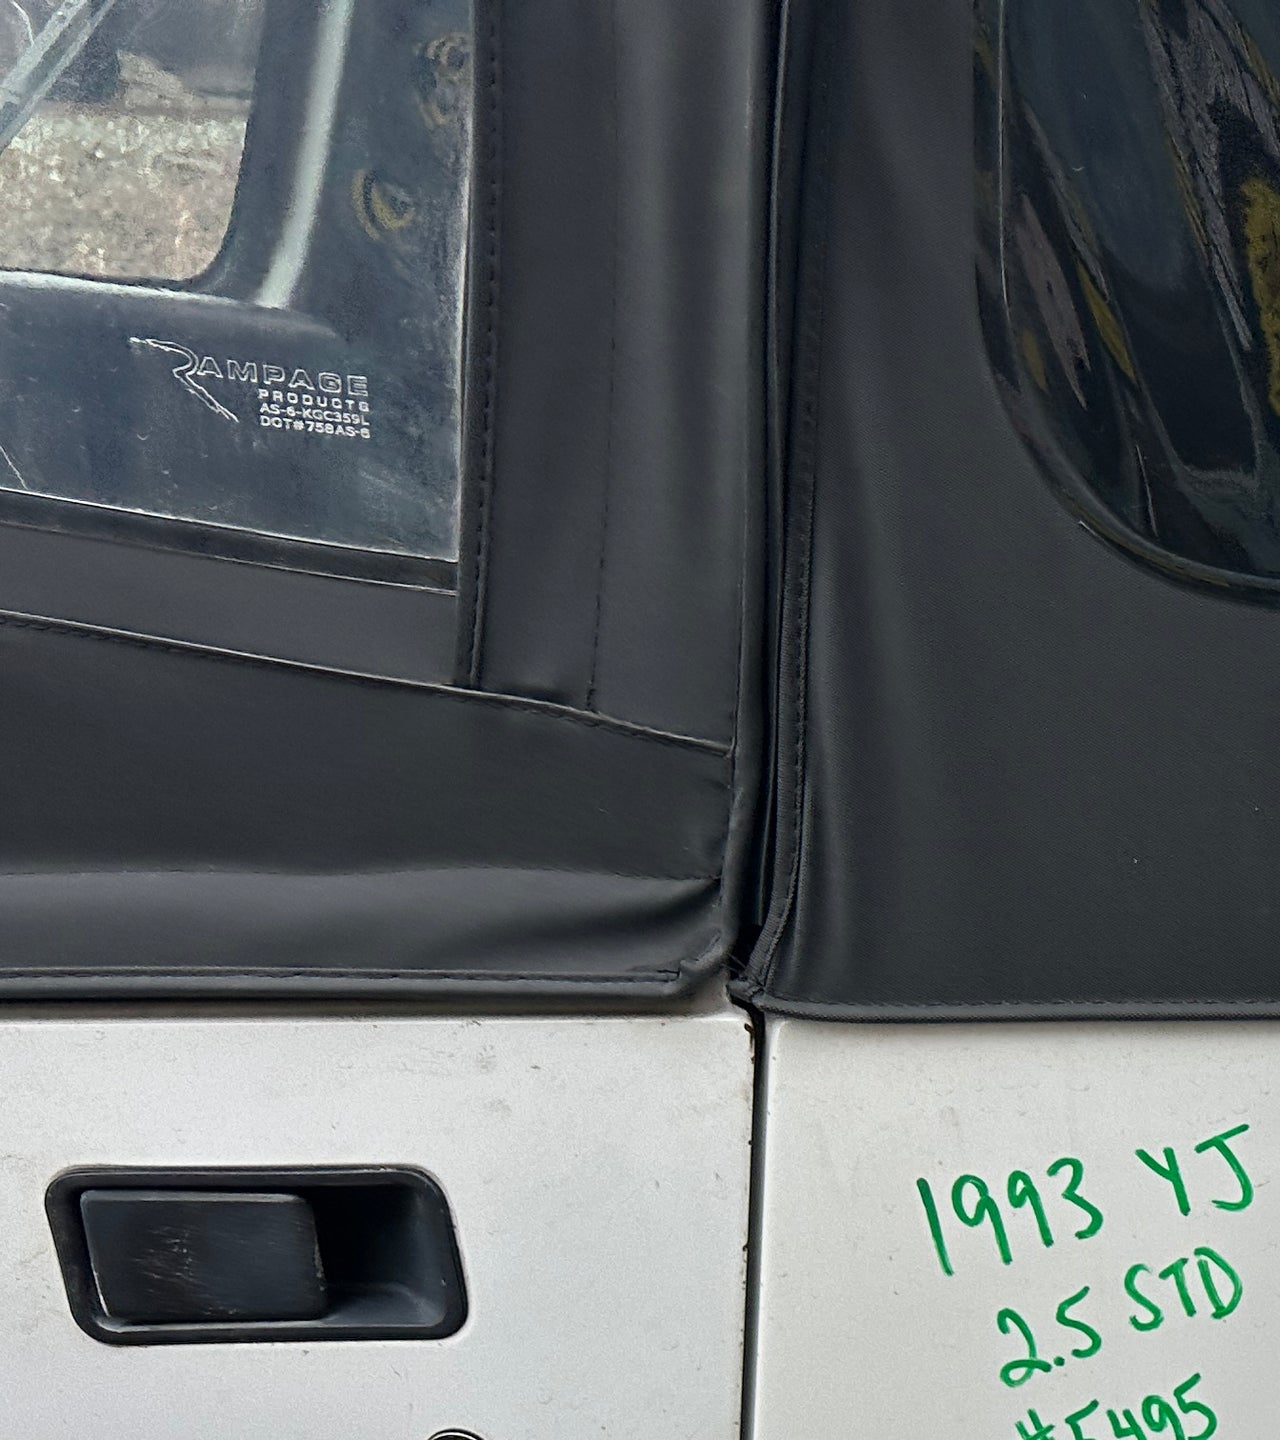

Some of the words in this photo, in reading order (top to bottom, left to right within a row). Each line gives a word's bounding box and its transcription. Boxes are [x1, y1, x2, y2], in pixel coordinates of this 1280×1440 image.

[129, 337, 369, 423] RAMPAGE
[257, 388, 369, 413] PRODUCTS
[917, 1157, 1104, 1277] 1993
[1135, 1123, 1254, 1217] YJ
[997, 1286, 1102, 1388] 2.5
[1124, 1246, 1243, 1332] STD
